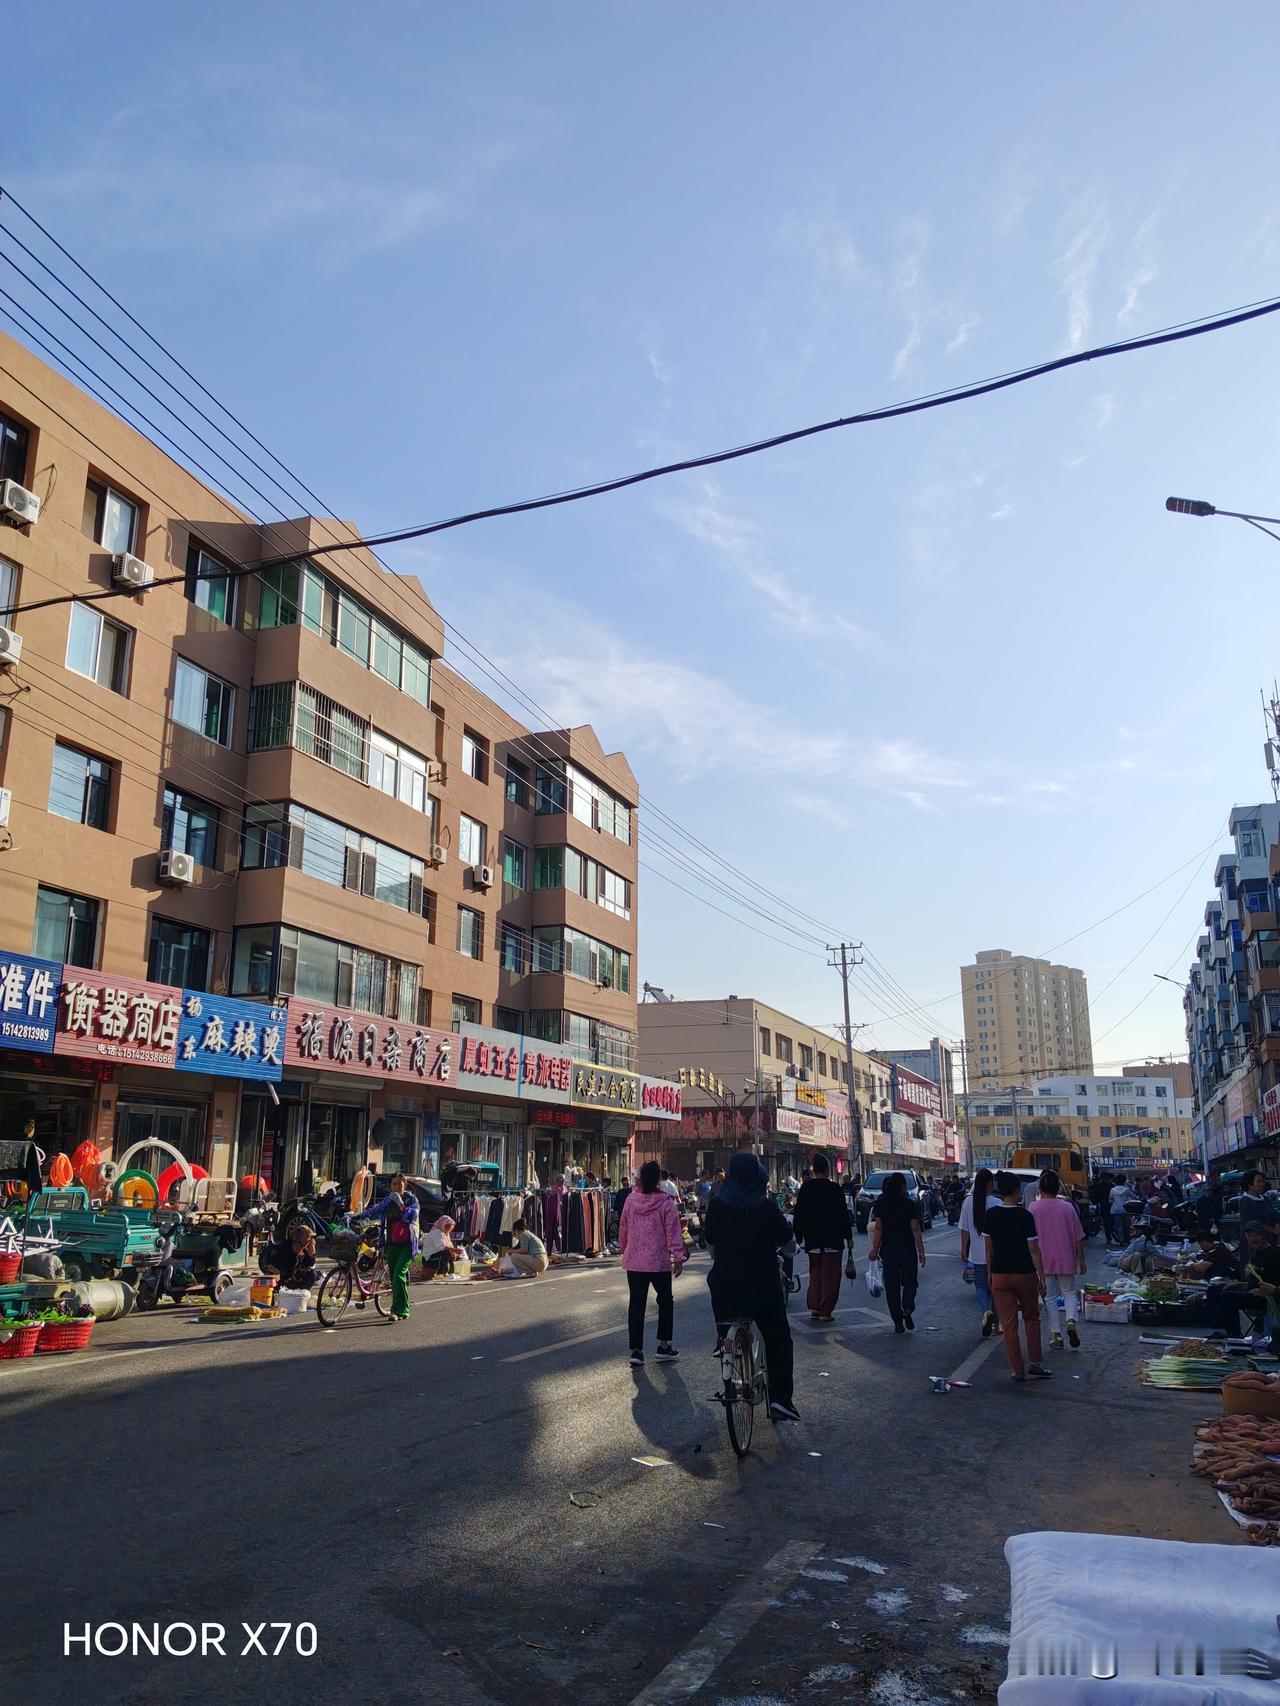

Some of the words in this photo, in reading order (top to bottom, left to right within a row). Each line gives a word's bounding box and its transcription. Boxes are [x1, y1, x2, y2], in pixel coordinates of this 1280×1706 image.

[2, 1022, 49, 1041] 15142813989
[65, 982, 182, 1049] 衡器商店
[199, 1015, 283, 1066] 麻辣烫
[299, 1011, 452, 1080] 福源日杂商店
[463, 1036, 520, 1079] 晨虹五金
